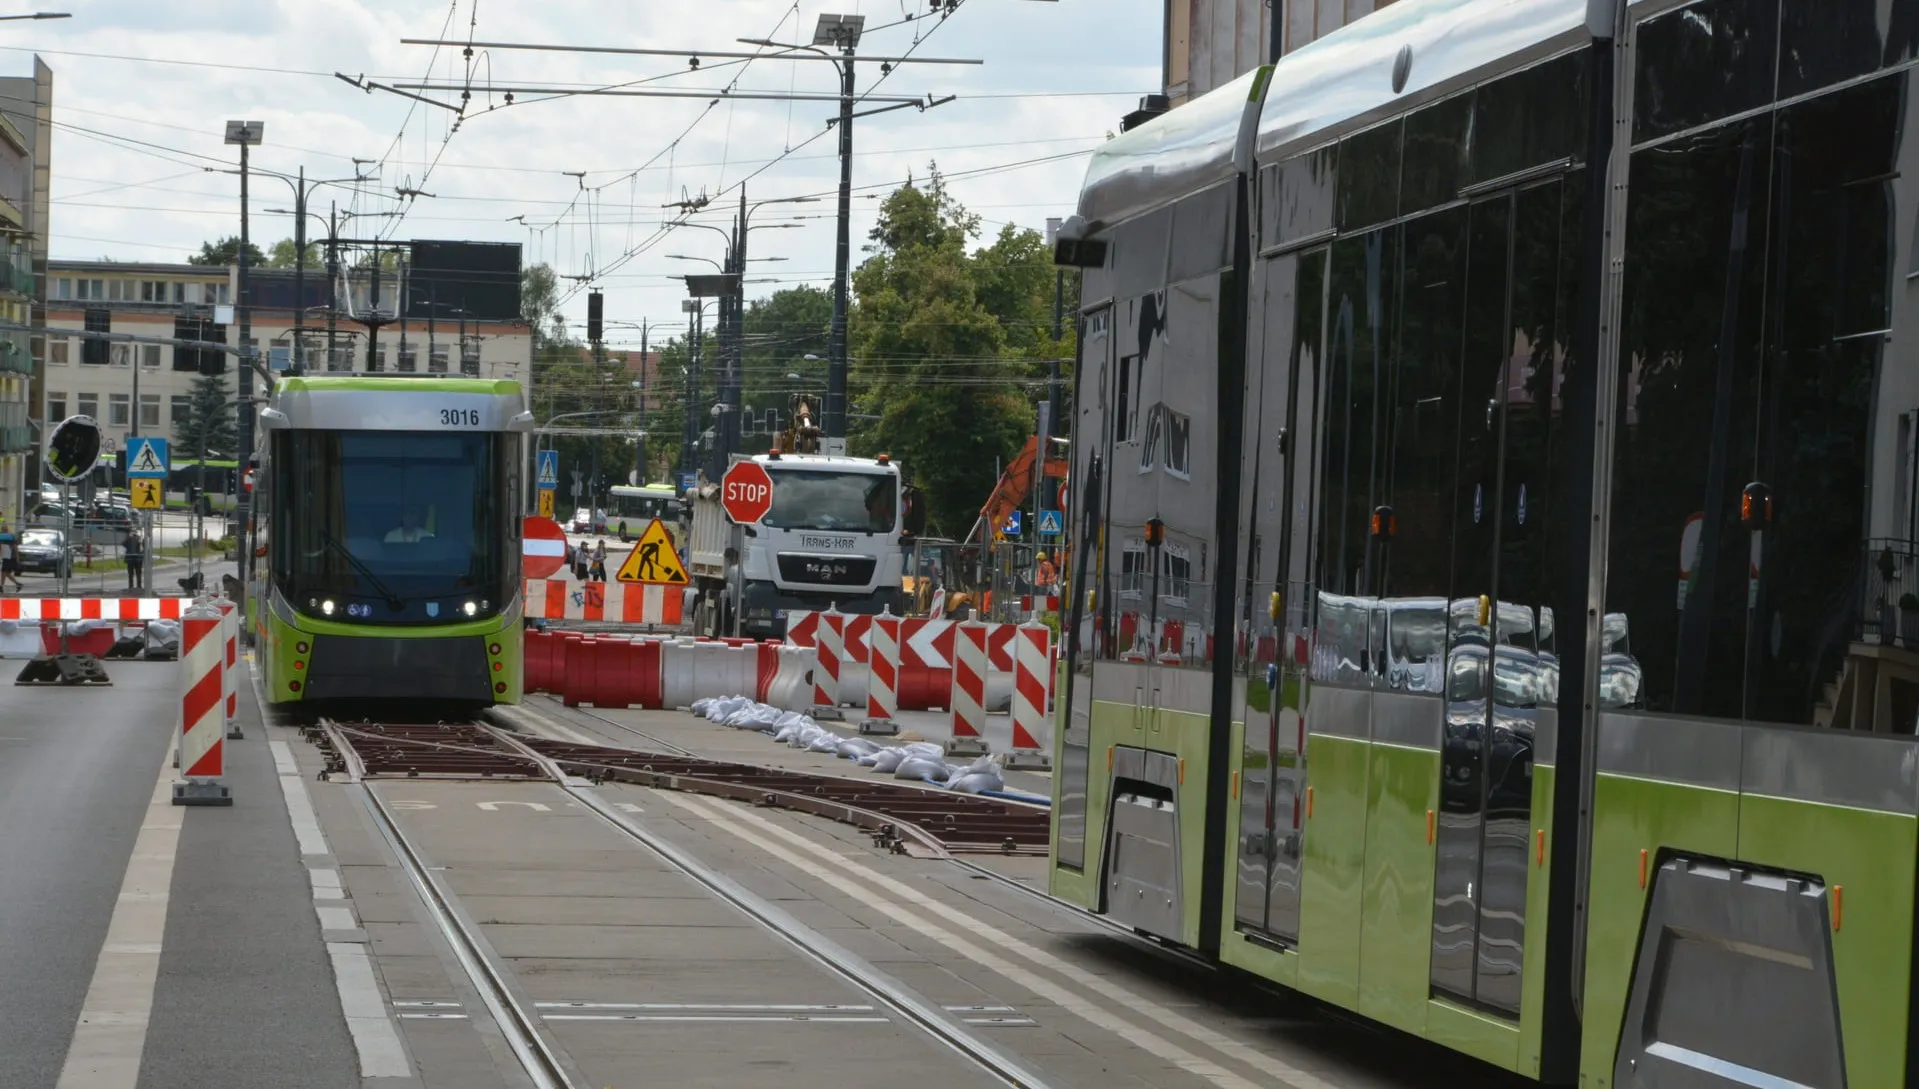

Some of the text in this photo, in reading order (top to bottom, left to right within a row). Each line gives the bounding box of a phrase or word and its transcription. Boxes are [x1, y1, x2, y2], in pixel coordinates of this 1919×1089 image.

[440, 408, 479, 426] 3016
[727, 481, 768, 503] STOP
[806, 563, 847, 575] MAN
